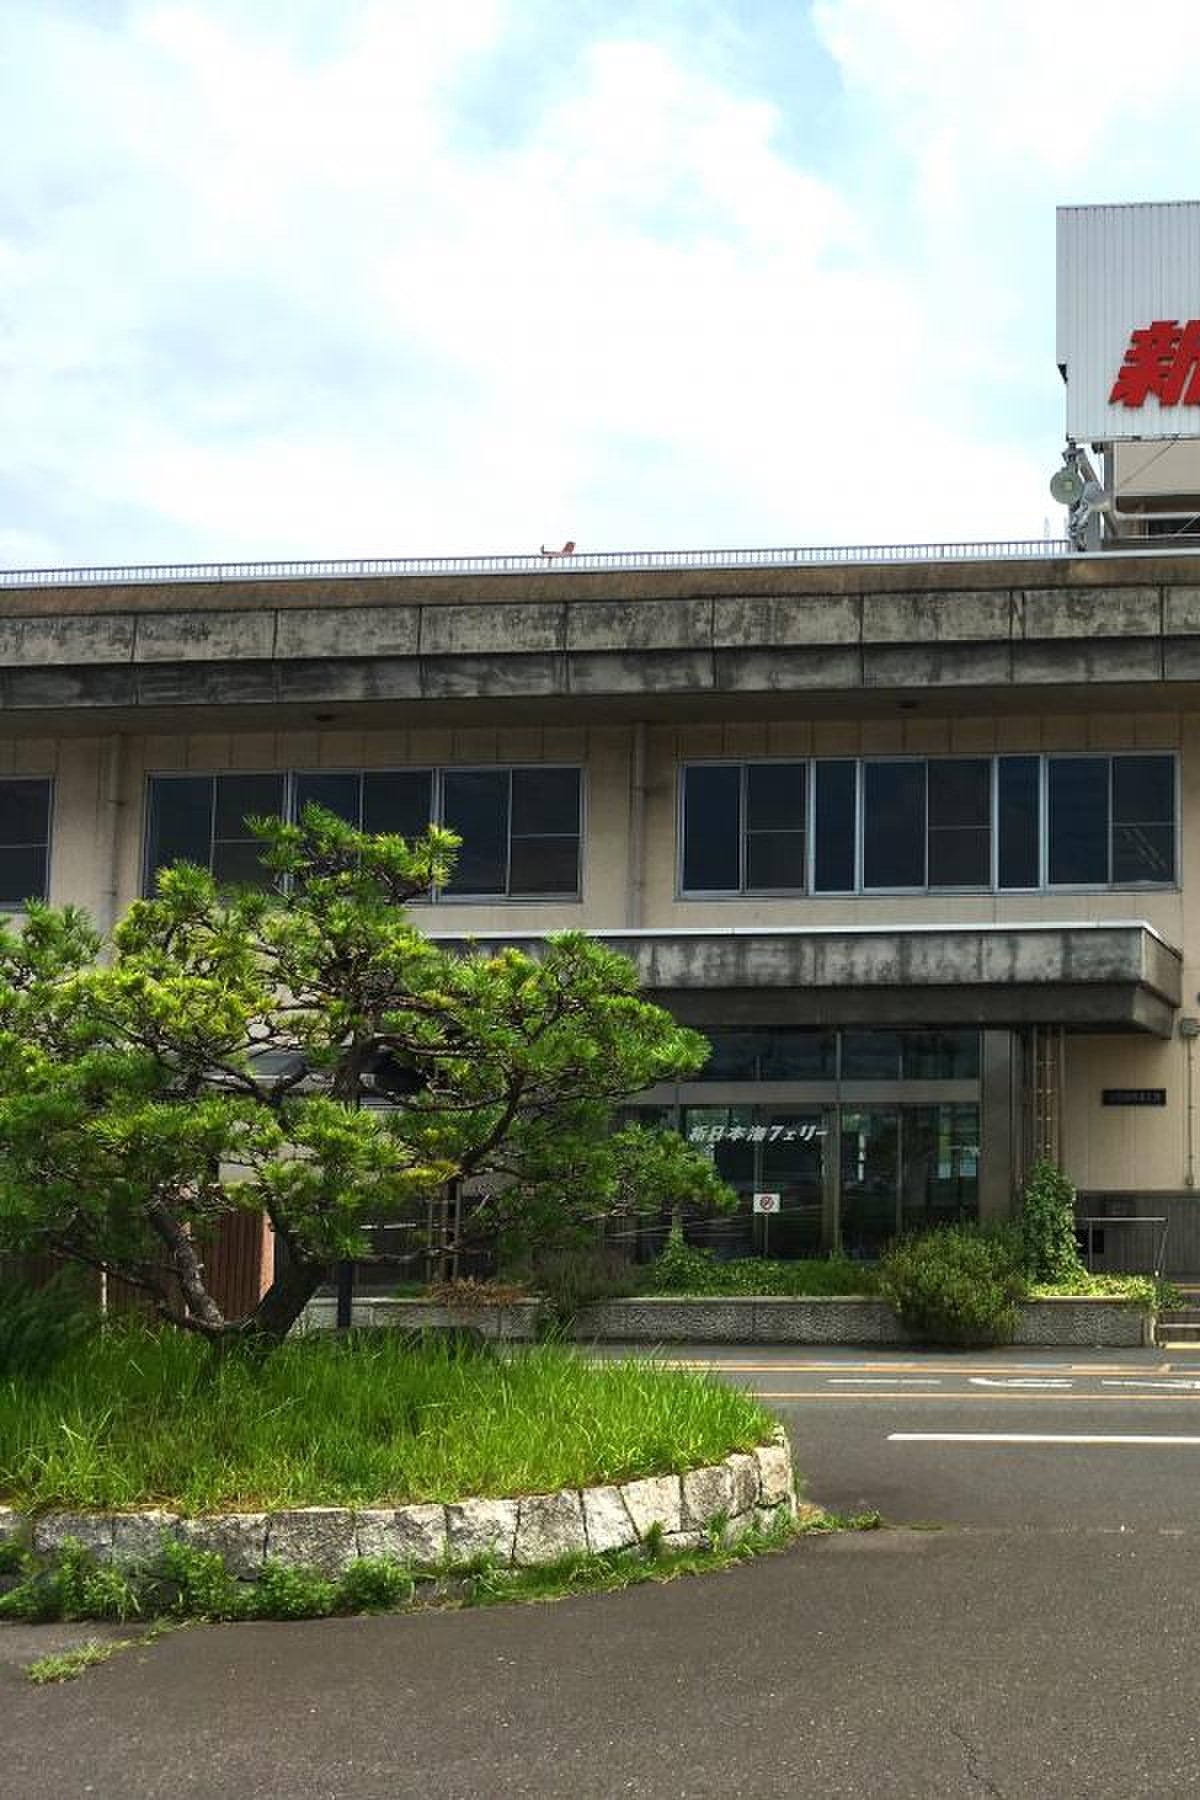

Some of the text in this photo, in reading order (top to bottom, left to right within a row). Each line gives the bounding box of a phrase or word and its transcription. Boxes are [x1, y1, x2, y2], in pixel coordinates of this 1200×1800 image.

[688, 1124, 829, 1142] 新日本海フェリー
